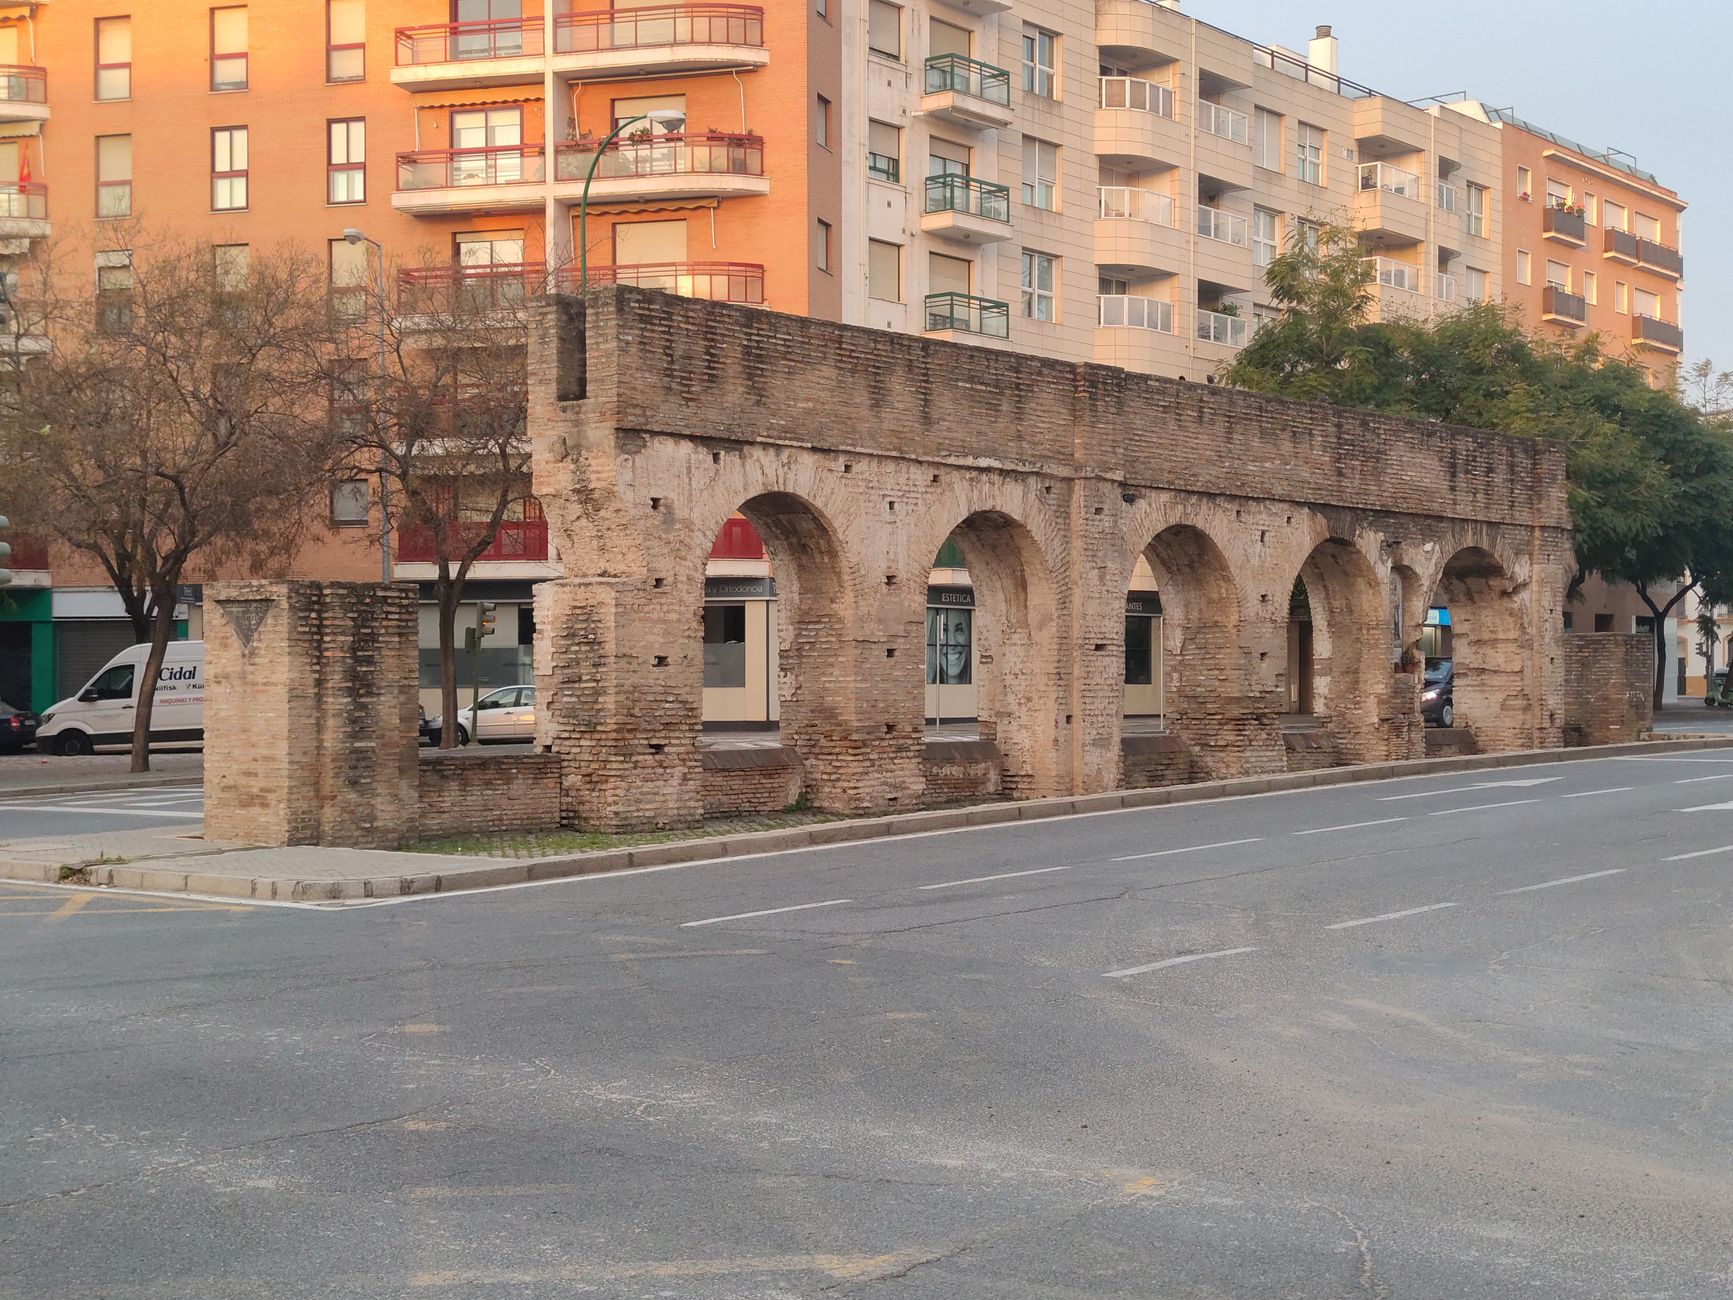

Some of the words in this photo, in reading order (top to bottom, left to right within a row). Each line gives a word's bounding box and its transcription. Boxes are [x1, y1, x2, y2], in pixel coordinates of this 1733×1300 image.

[719, 584, 763, 594] Ortodoncia
[941, 592, 971, 603] ESTETICA
[159, 665, 197, 681] Cidal
